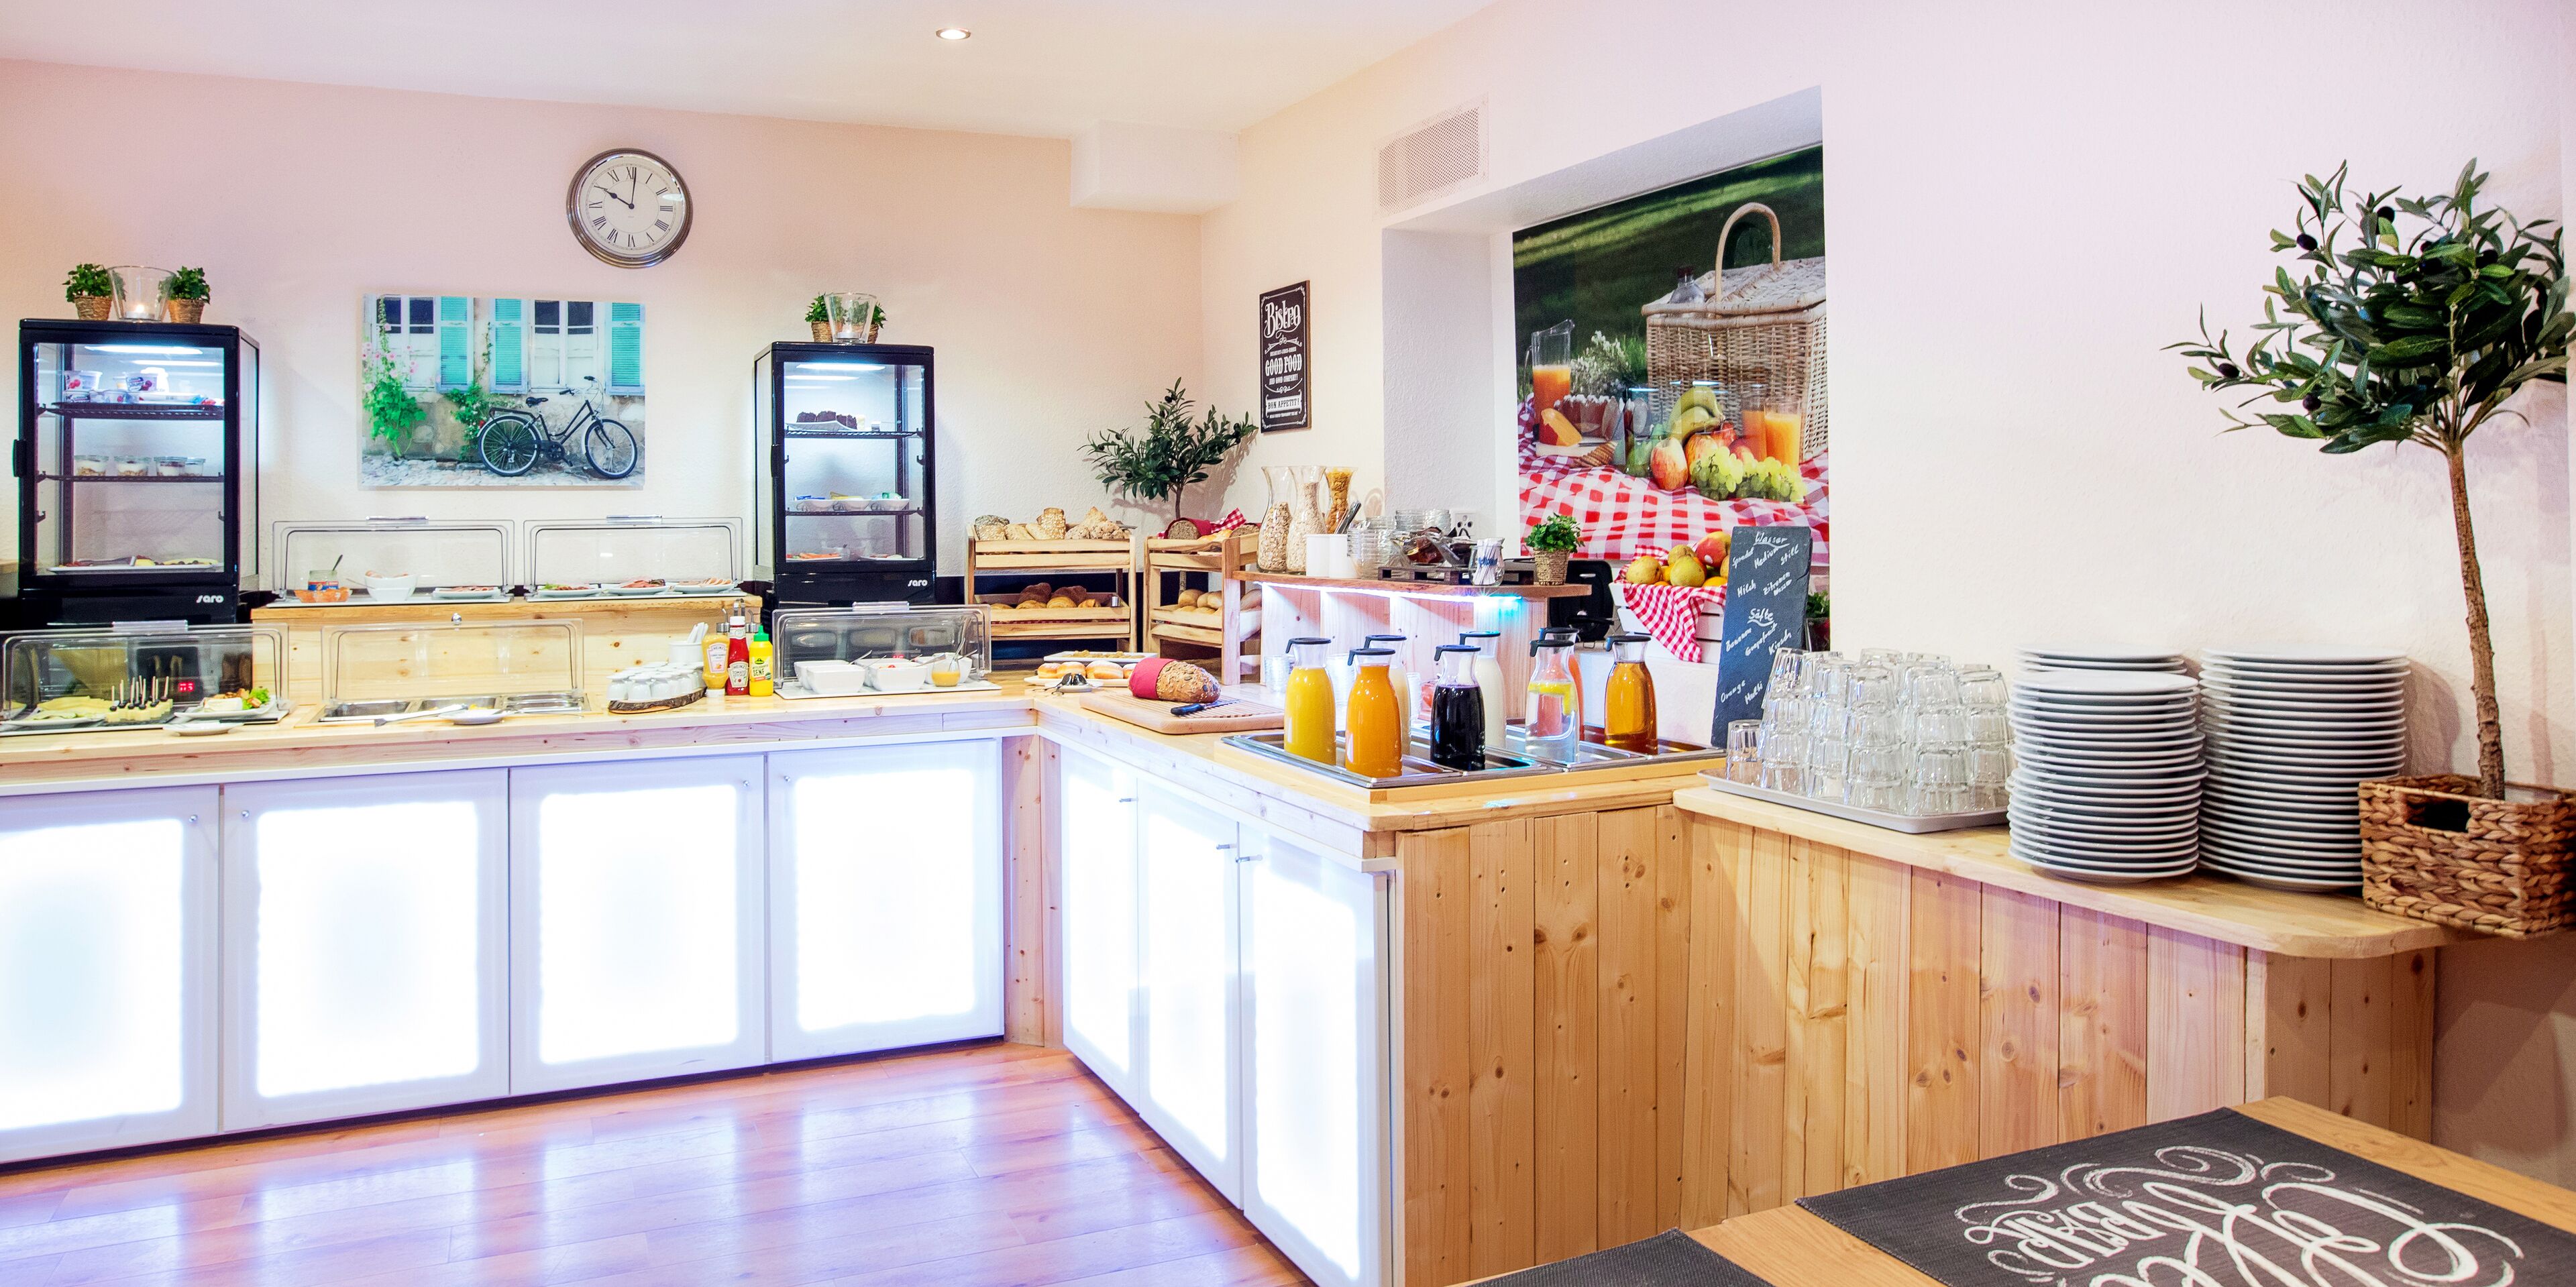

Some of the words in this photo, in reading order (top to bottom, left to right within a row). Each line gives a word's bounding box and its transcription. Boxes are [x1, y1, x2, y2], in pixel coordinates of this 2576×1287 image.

[1264, 300, 1301, 339] Bistro
[1265, 357, 1283, 376] GOOD
[1284, 353, 1302, 374] FOOD
[1268, 401, 1277, 409] BON
[1754, 531, 1788, 544] Wasser
[1754, 547, 1779, 569] Medium
[1780, 544, 1799, 565] Still
[1737, 579, 1756, 598] Milch
[196, 595, 224, 604] saro
[1748, 608, 1774, 622] Säfte
[1768, 629, 1792, 655] Kirsch
[1721, 679, 1746, 703] Orange
